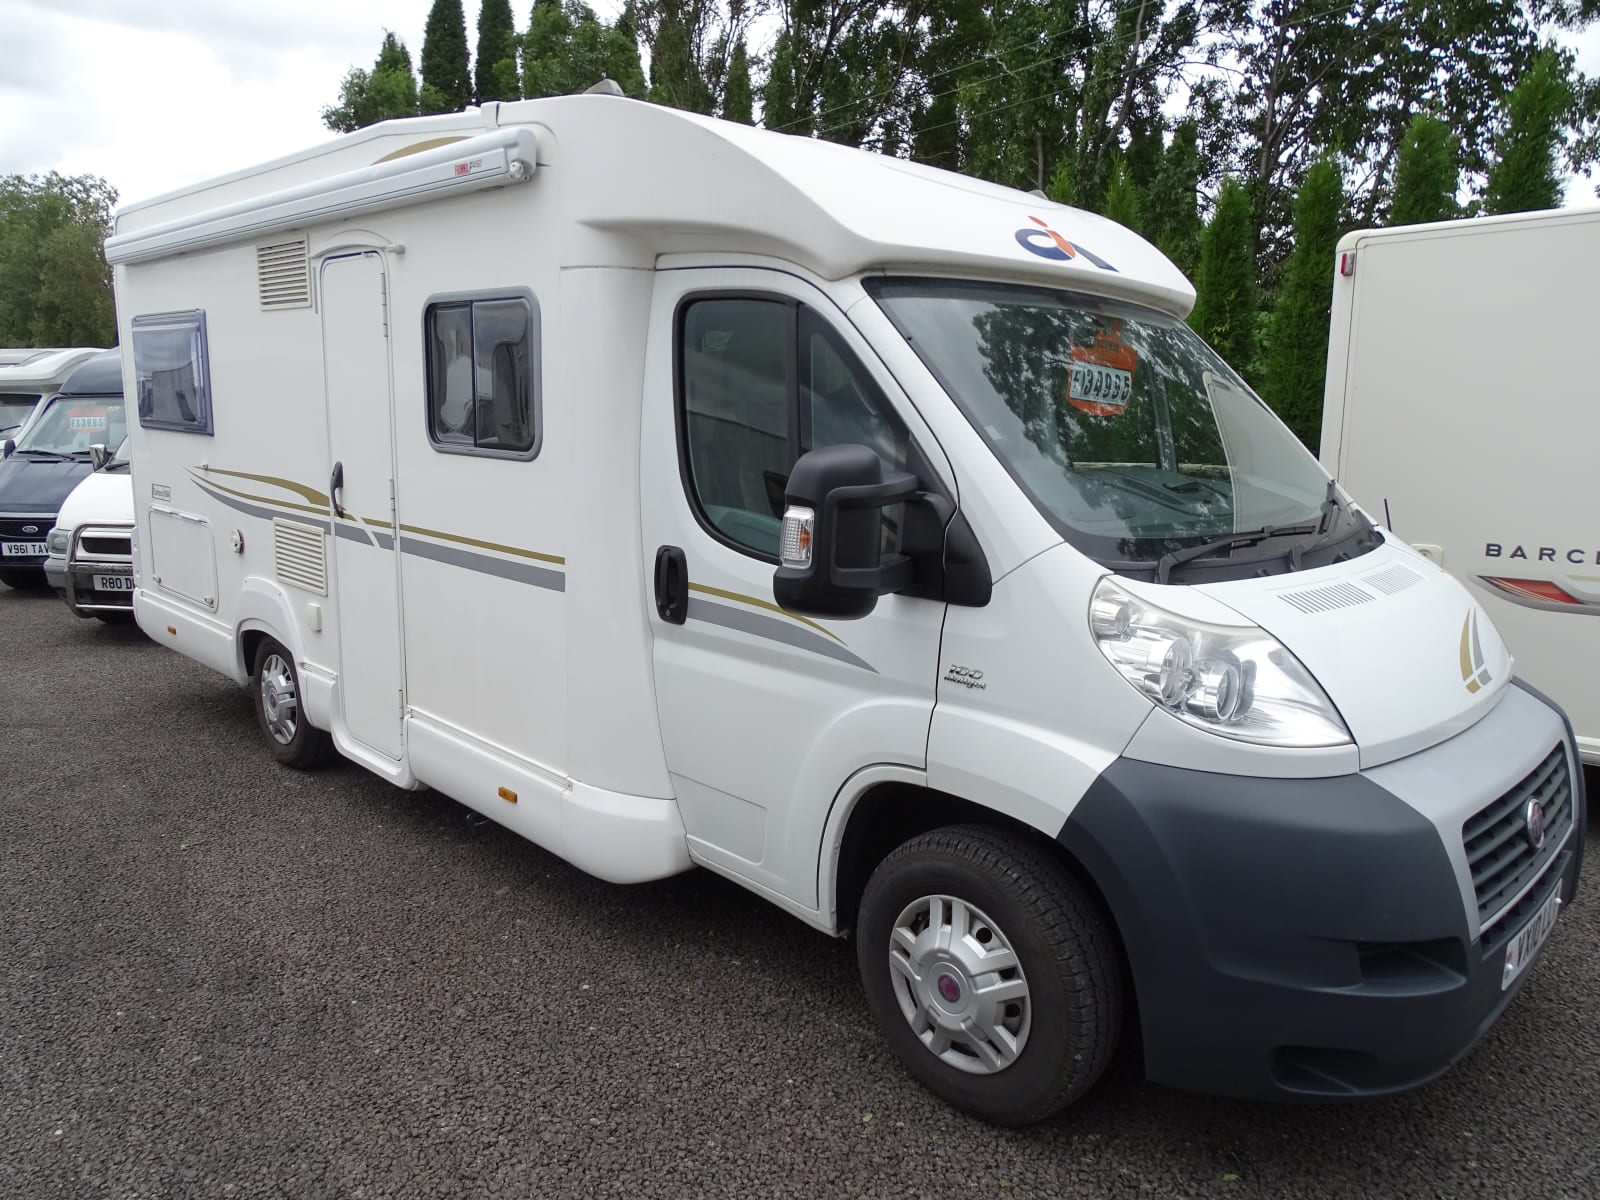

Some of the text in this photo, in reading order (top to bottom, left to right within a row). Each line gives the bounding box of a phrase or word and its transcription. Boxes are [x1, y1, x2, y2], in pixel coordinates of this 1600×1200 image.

[7, 544, 28, 554] V961
[1485, 543, 1600, 566] BARC
[101, 576, 122, 589] R80
